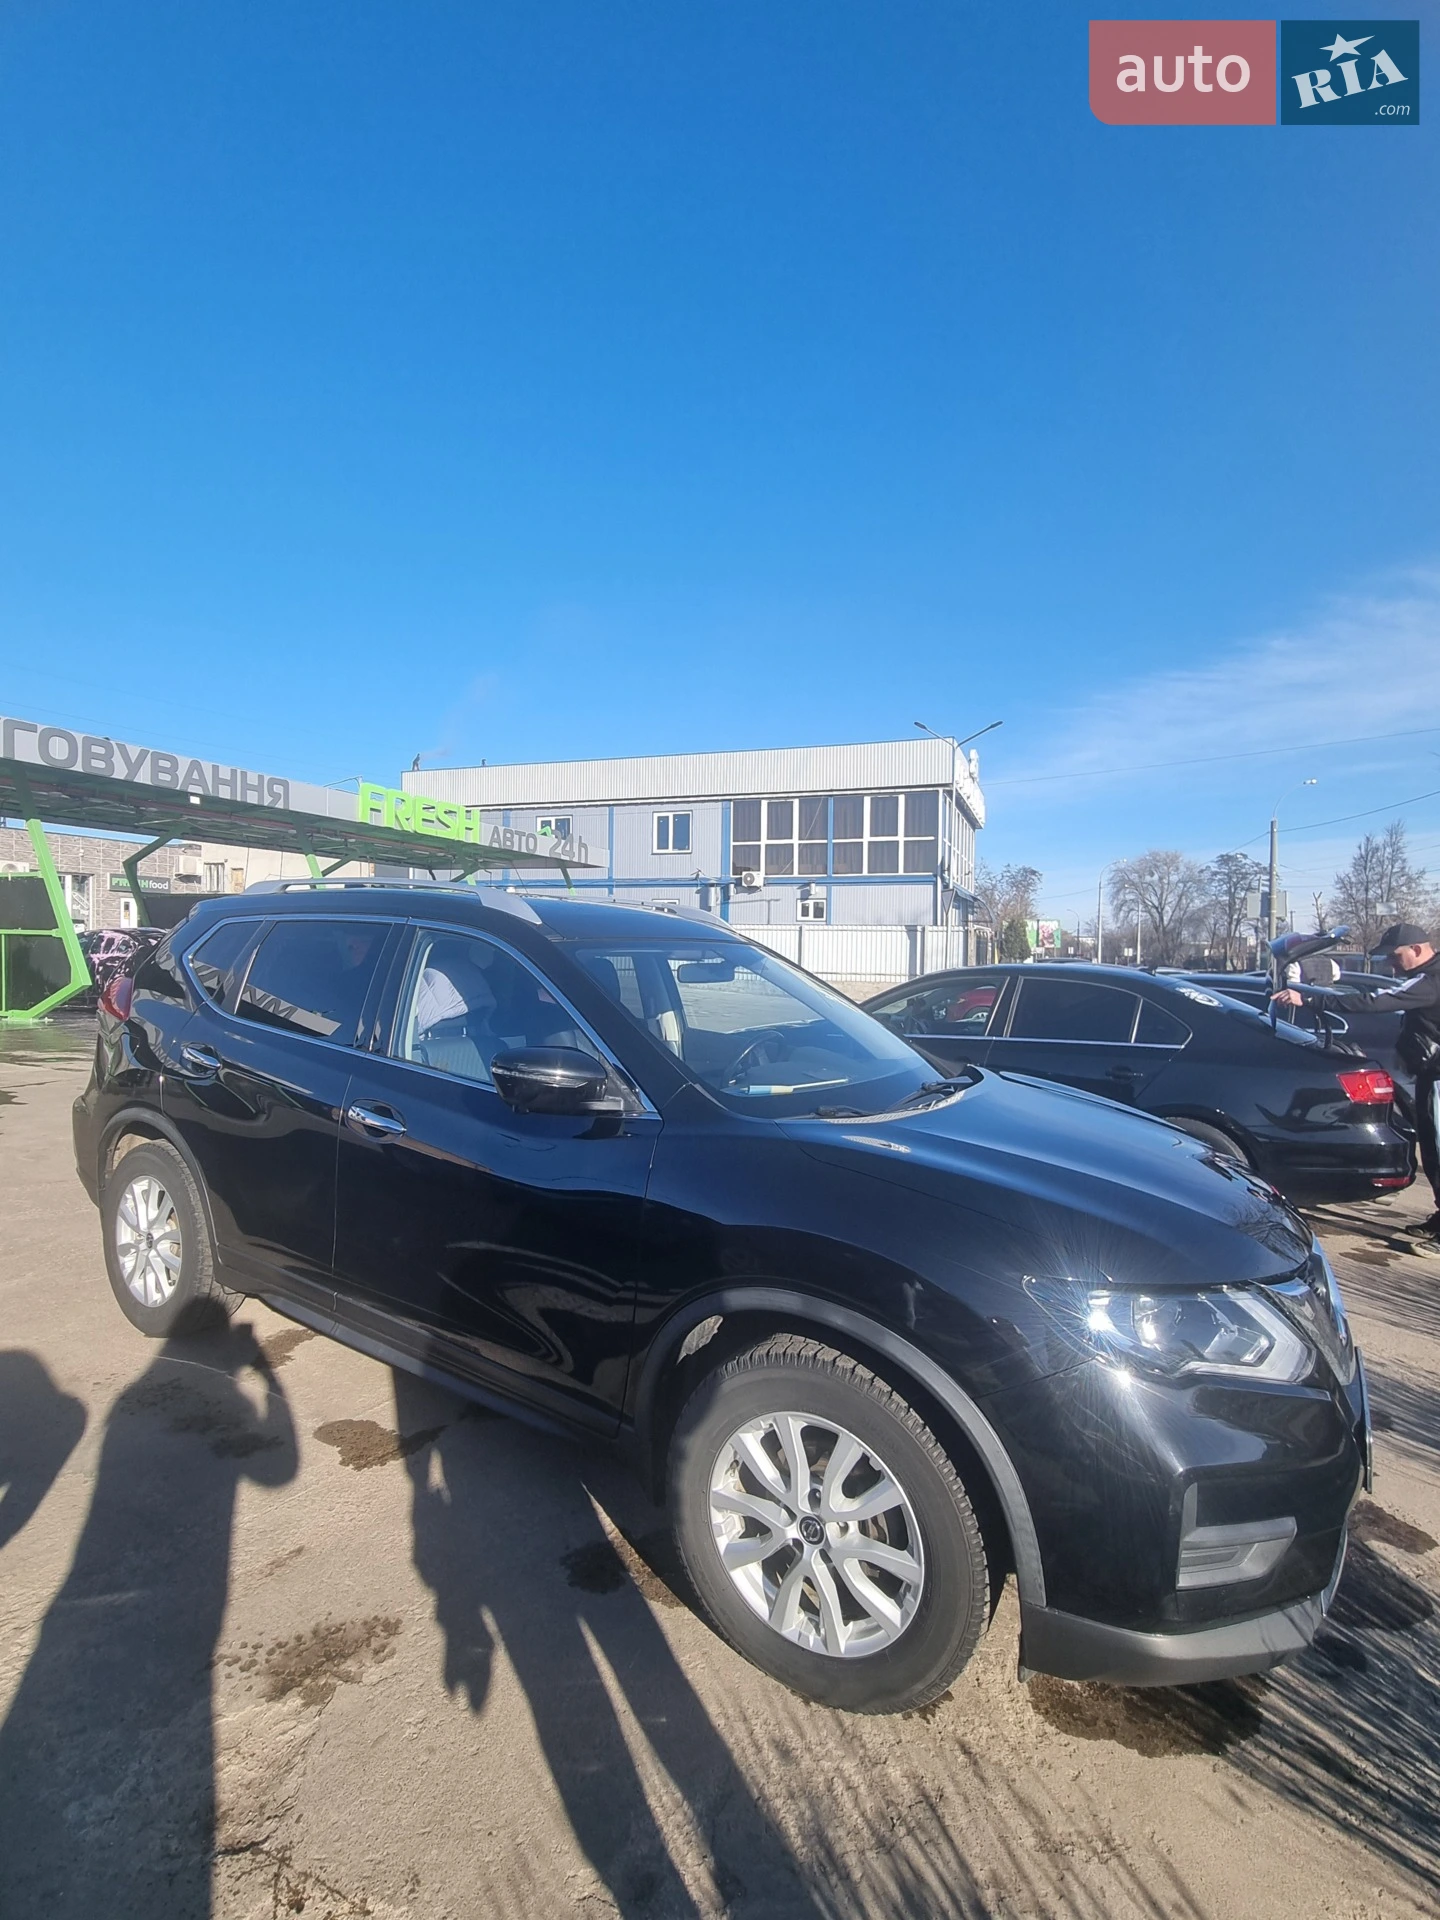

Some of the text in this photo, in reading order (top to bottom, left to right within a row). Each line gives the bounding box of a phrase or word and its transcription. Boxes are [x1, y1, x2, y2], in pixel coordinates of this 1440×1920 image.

[359, 782, 481, 844] FRESH
[489, 825, 538, 854] АВТО
[149, 880, 169, 890] food
